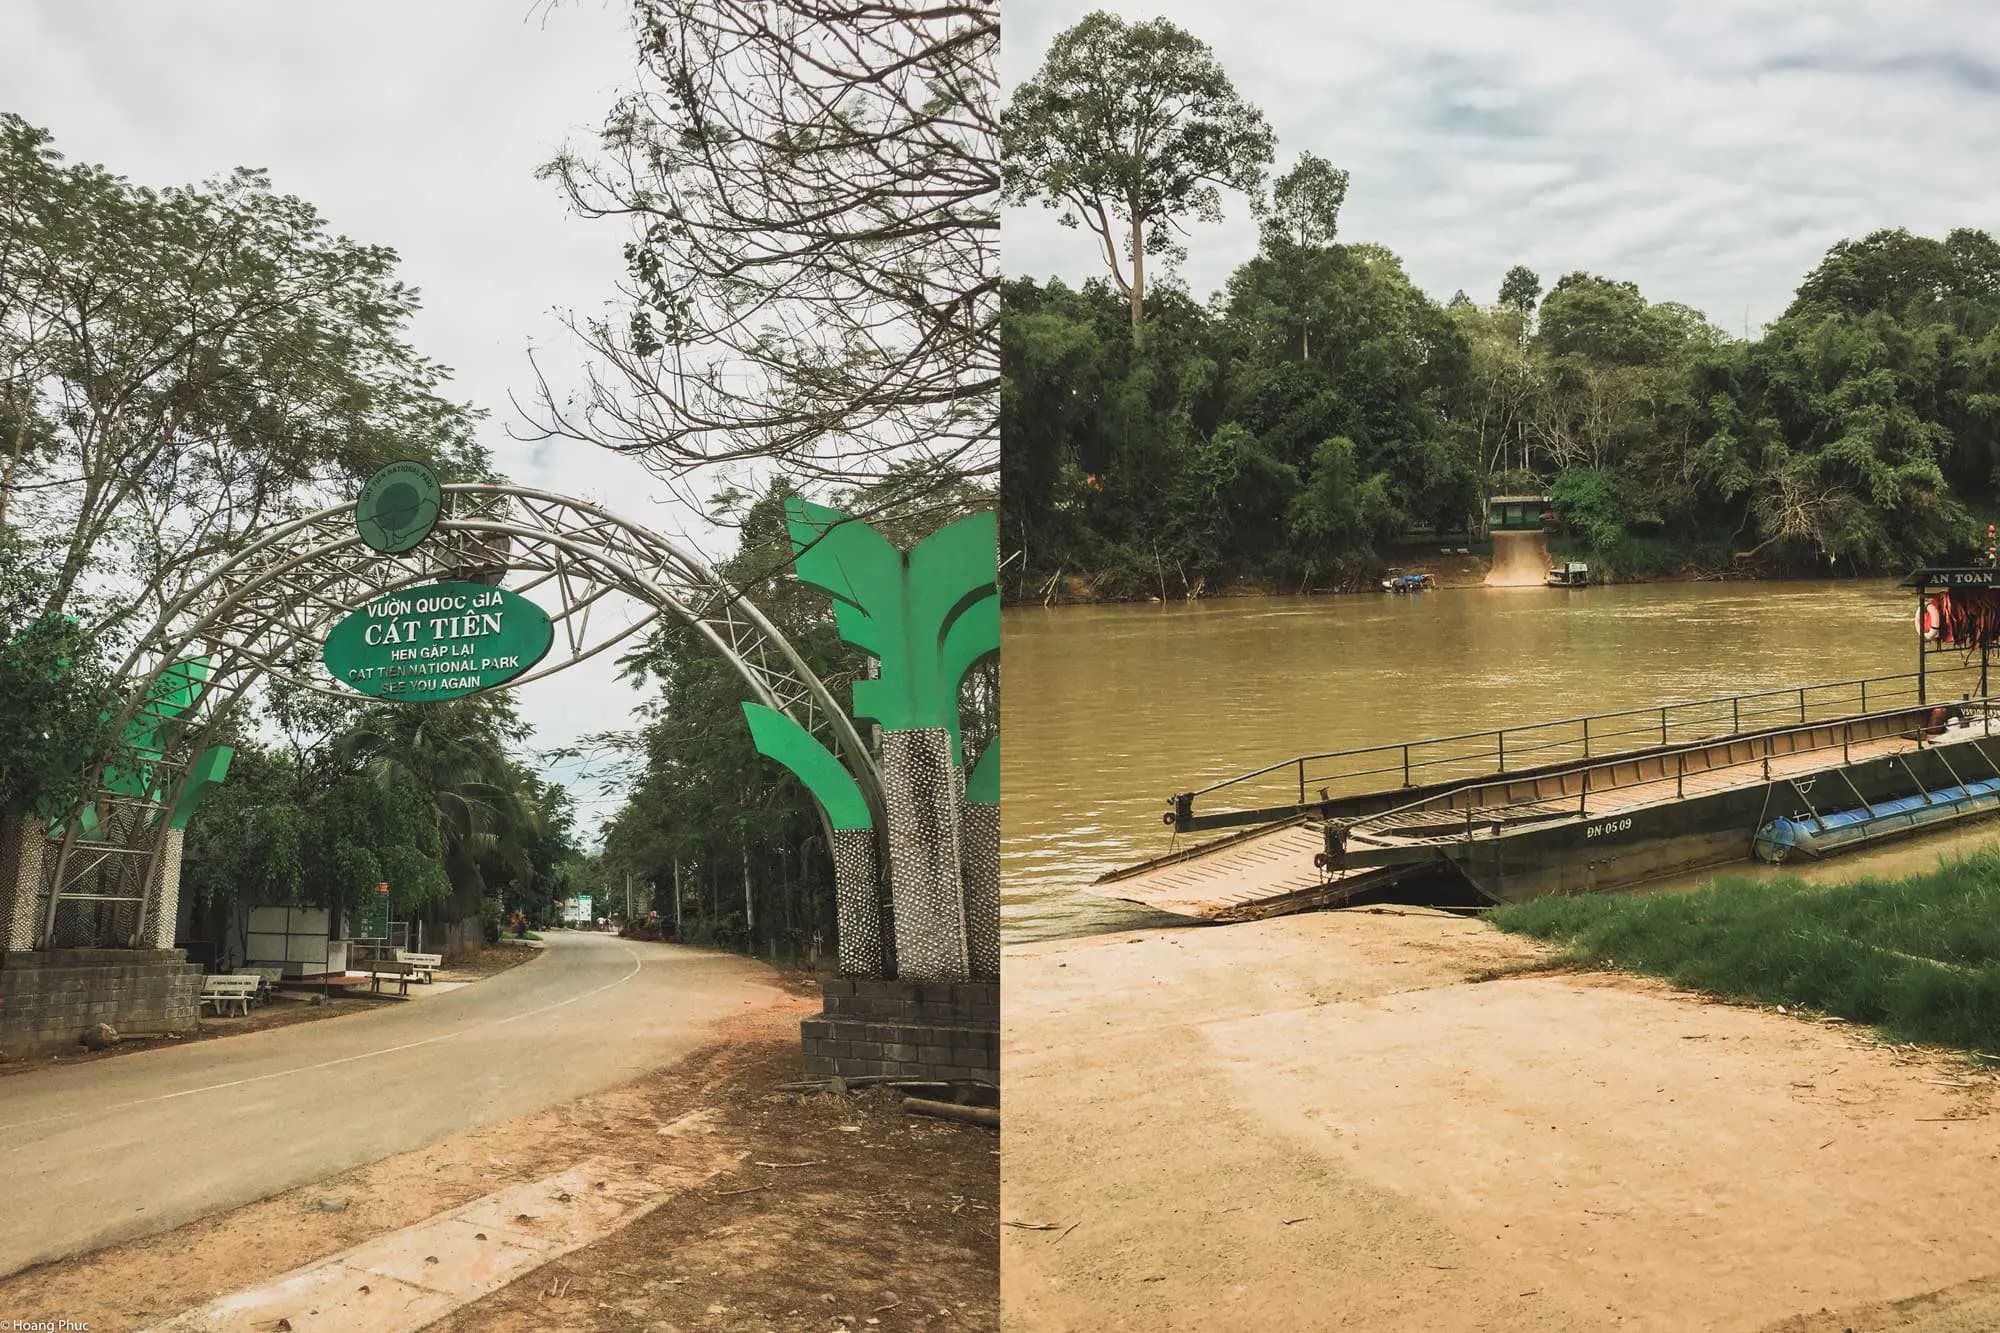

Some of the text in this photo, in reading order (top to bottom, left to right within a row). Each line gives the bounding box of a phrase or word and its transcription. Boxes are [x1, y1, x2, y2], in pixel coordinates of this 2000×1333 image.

[1930, 574, 1950, 584] AN
[367, 597, 411, 618] VƯỜN
[472, 591, 504, 608] GIA
[364, 609, 504, 646] CÁT TIÊN
[420, 643, 448, 661] GẶP
[451, 643, 474, 658] LẠI
[348, 655, 519, 681] CAT TIEN NATIONAL PARK
[382, 675, 481, 694] SEE YOU AGAIN
